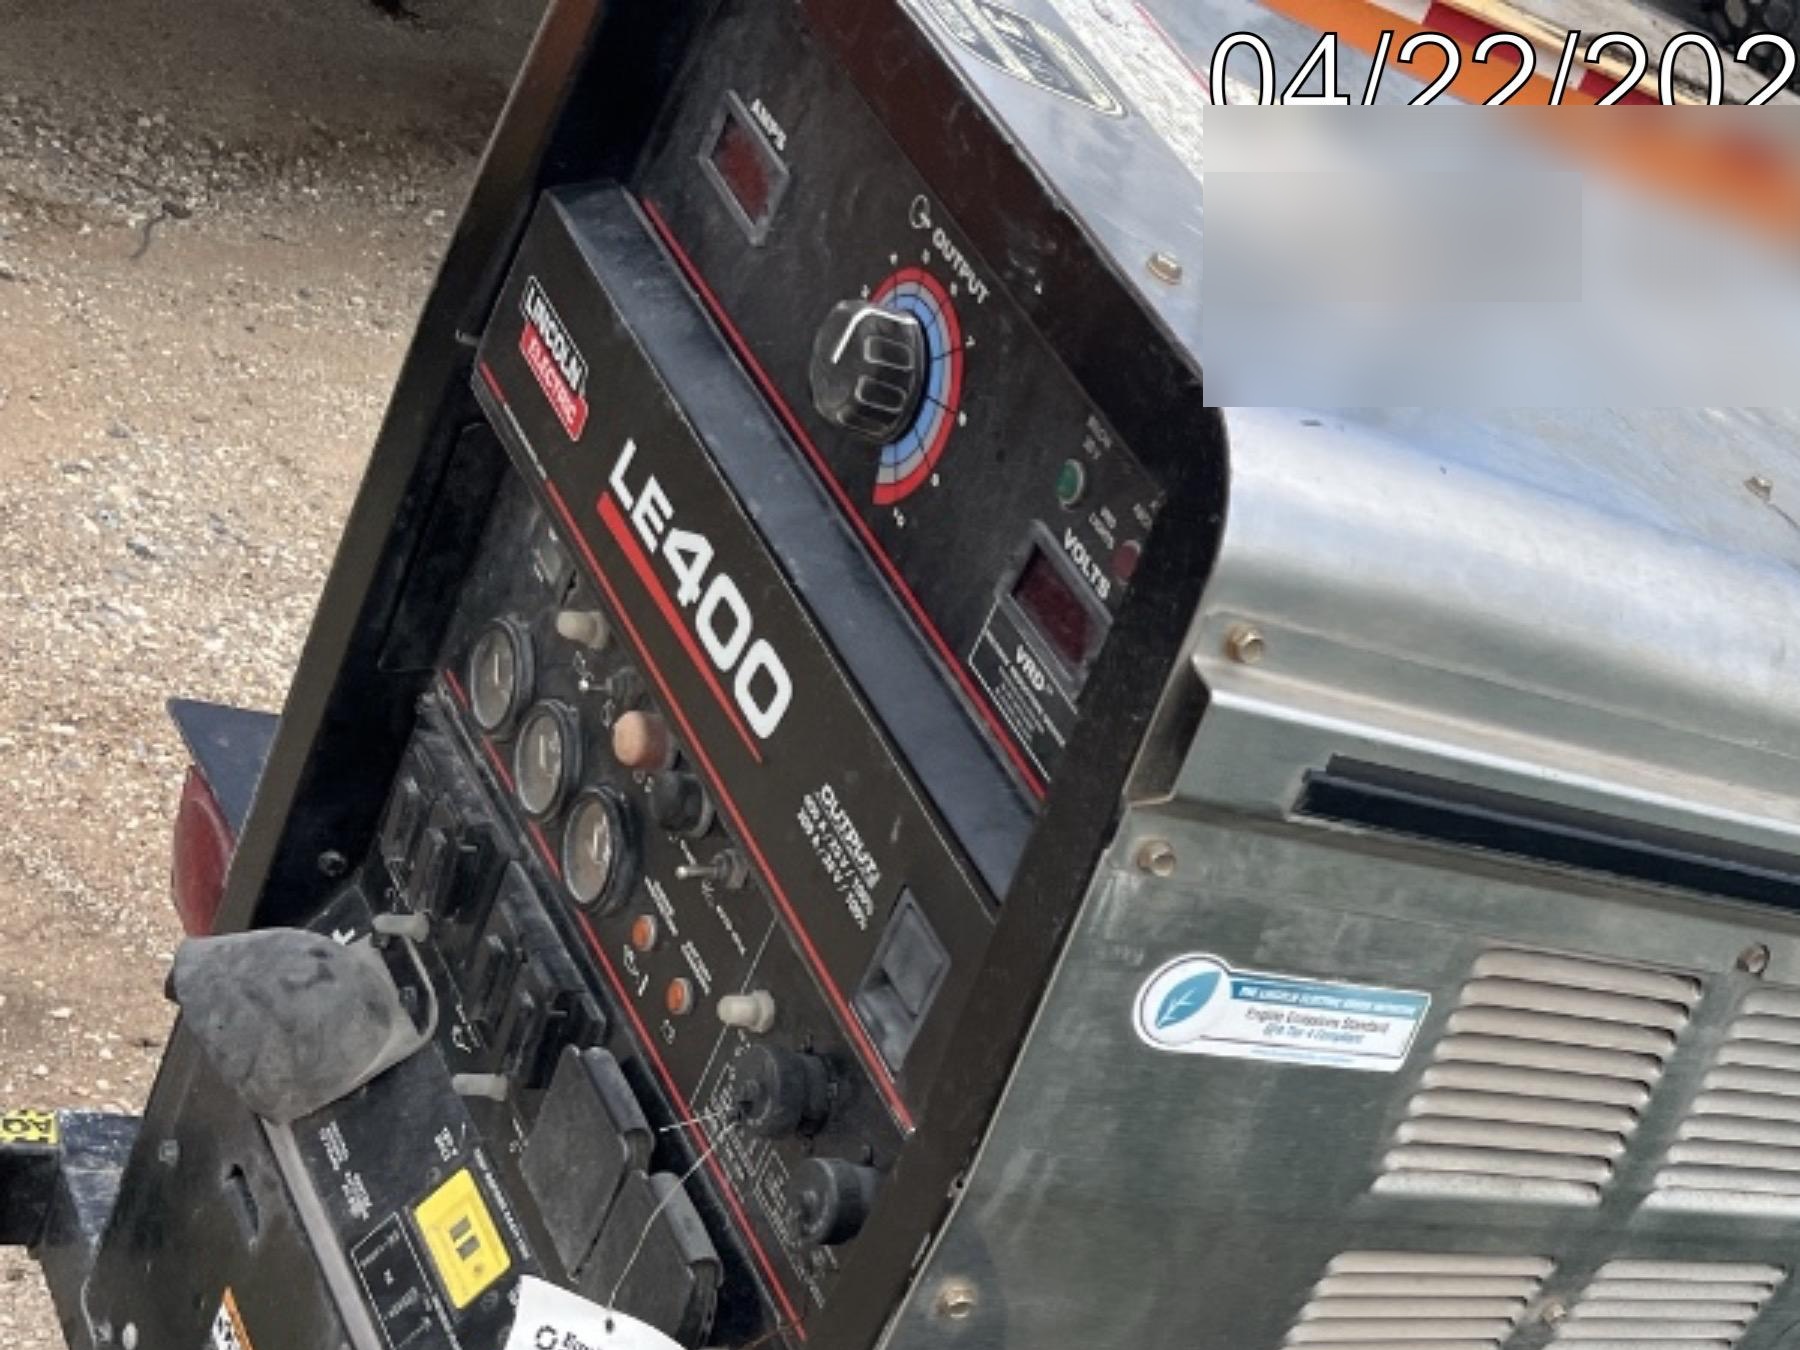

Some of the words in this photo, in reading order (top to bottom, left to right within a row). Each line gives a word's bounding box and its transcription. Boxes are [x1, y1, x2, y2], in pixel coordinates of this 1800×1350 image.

[932, 227, 989, 303] OUTPUT
[525, 287, 583, 393] LINCOLN
[608, 438, 793, 739] LE400
[1064, 527, 1111, 600] VOLTS
